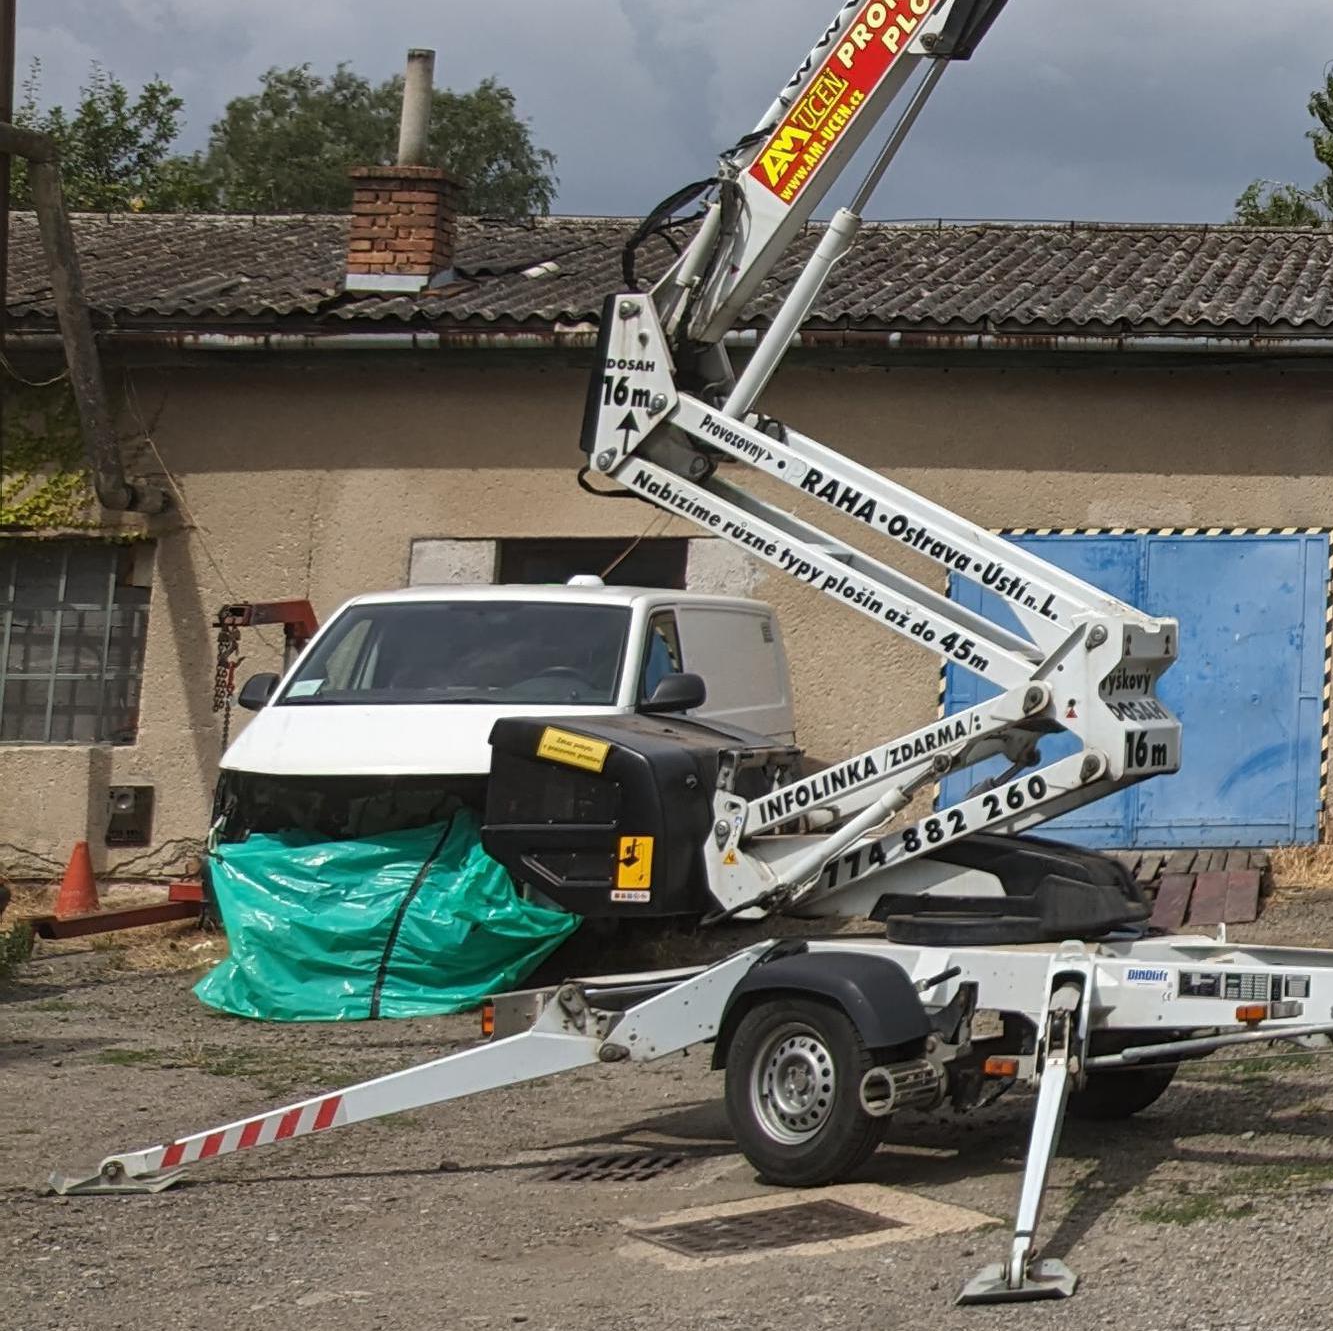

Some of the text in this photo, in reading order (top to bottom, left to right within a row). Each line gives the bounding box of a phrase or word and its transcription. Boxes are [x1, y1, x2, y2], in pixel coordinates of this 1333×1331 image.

[759, 125, 813, 188] AM
[606, 358, 656, 372] DOSAH
[699, 413, 767, 463] Provozovny
[632, 469, 721, 526] Nabízíme
[722, 521, 779, 557] různé
[779, 547, 825, 583] typy
[820, 573, 884, 614] plošin
[884, 607, 913, 629] až
[910, 620, 936, 643] do
[887, 514, 972, 572] Ostrava
[981, 561, 1030, 602] Ústí
[1105, 700, 1168, 721] DOSAH
[758, 756, 879, 825] INFOLINKA
[822, 774, 1048, 889] 774 882 260
